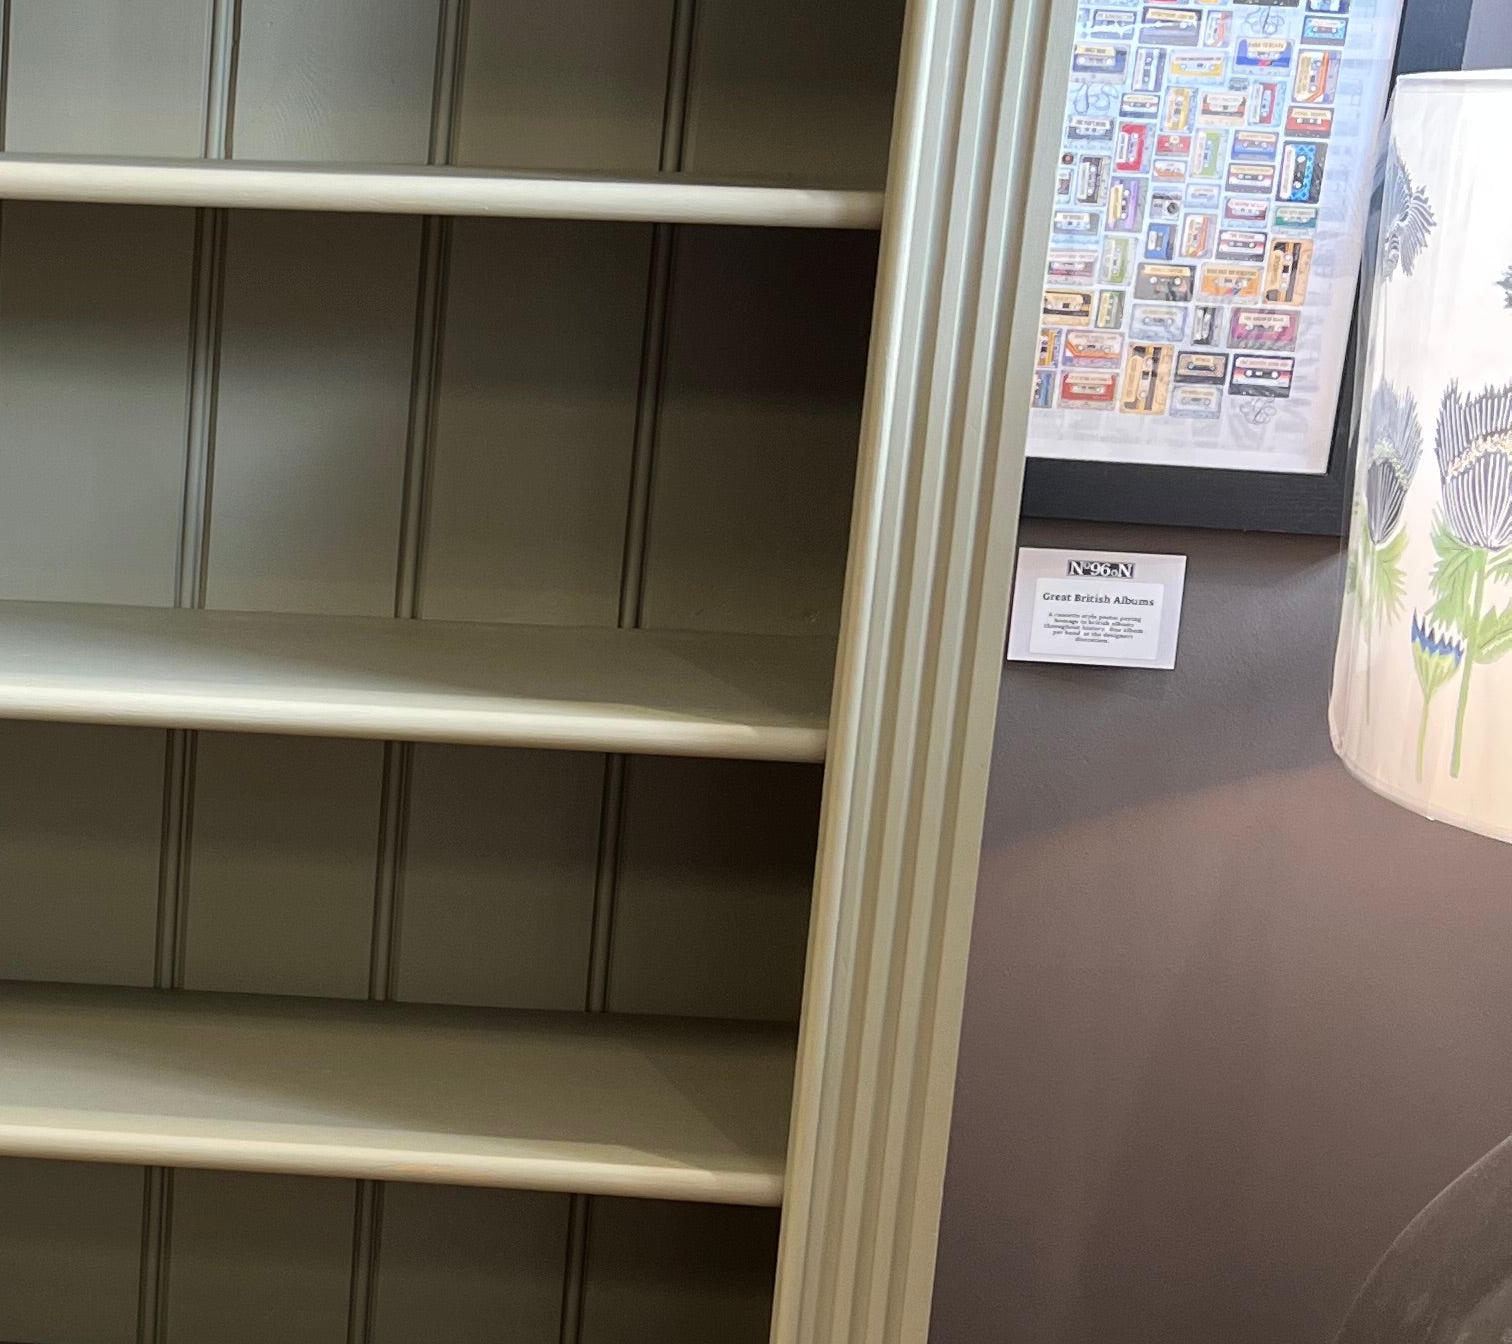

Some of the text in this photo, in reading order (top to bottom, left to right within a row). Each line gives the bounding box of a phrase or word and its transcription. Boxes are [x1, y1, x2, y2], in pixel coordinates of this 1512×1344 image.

[1042, 592, 1155, 607] Great British Albums
